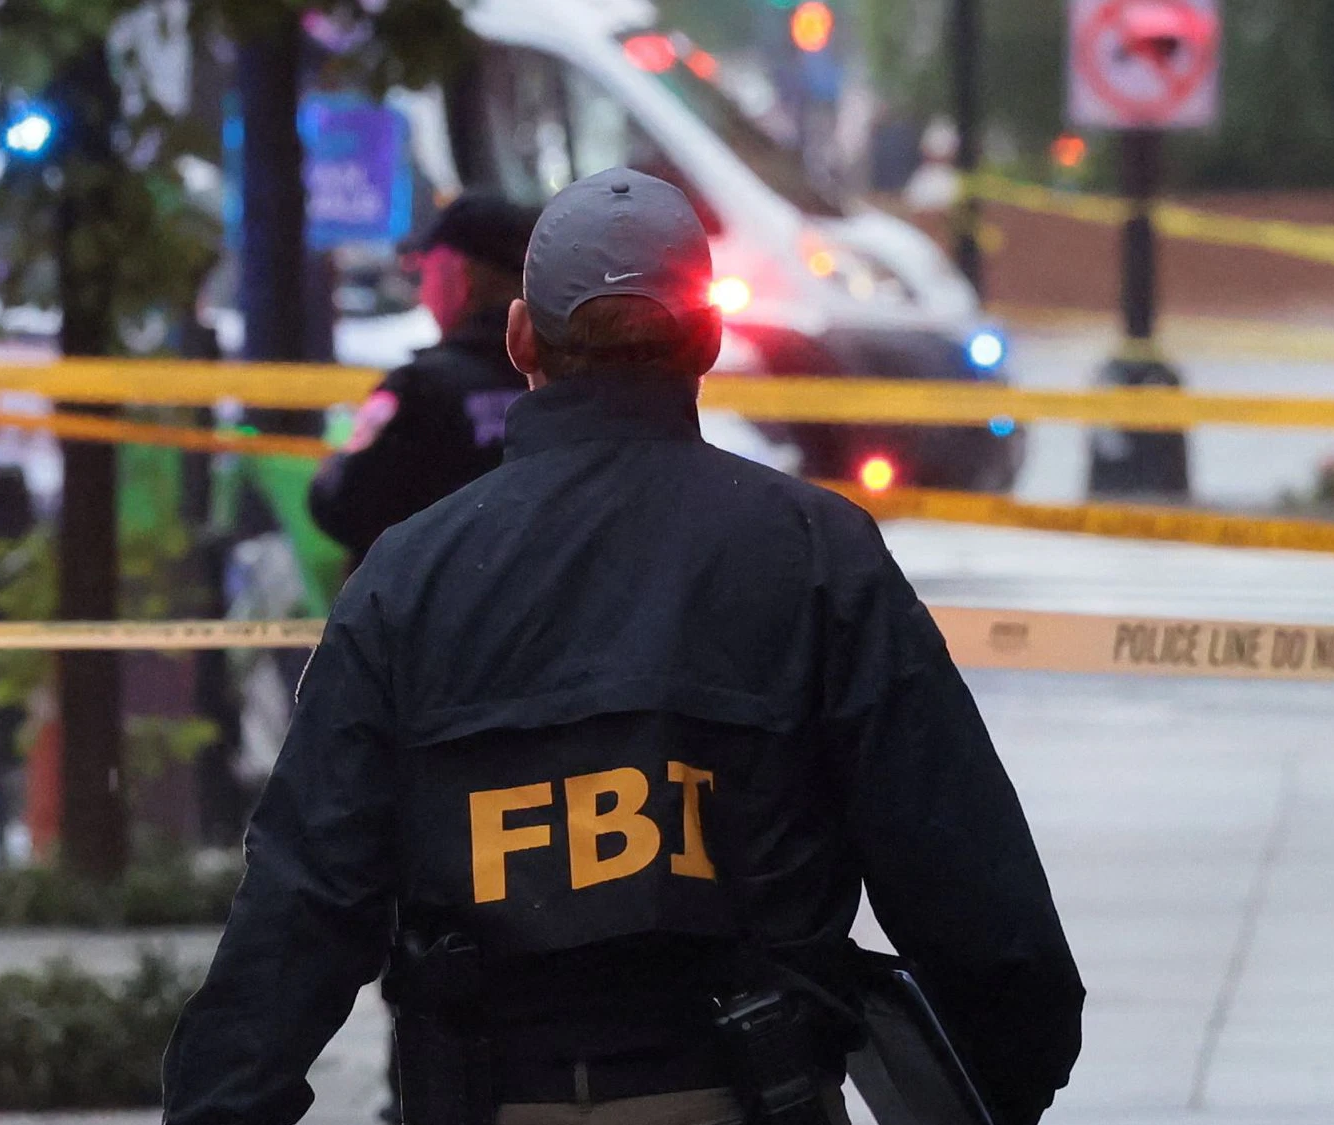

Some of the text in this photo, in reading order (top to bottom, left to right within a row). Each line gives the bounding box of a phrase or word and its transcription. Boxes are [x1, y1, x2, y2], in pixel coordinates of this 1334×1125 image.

[1113, 622, 1200, 667] POLICE
[1208, 626, 1262, 669] LINE
[1270, 627, 1307, 671] DO
[470, 761, 715, 903] FBI
